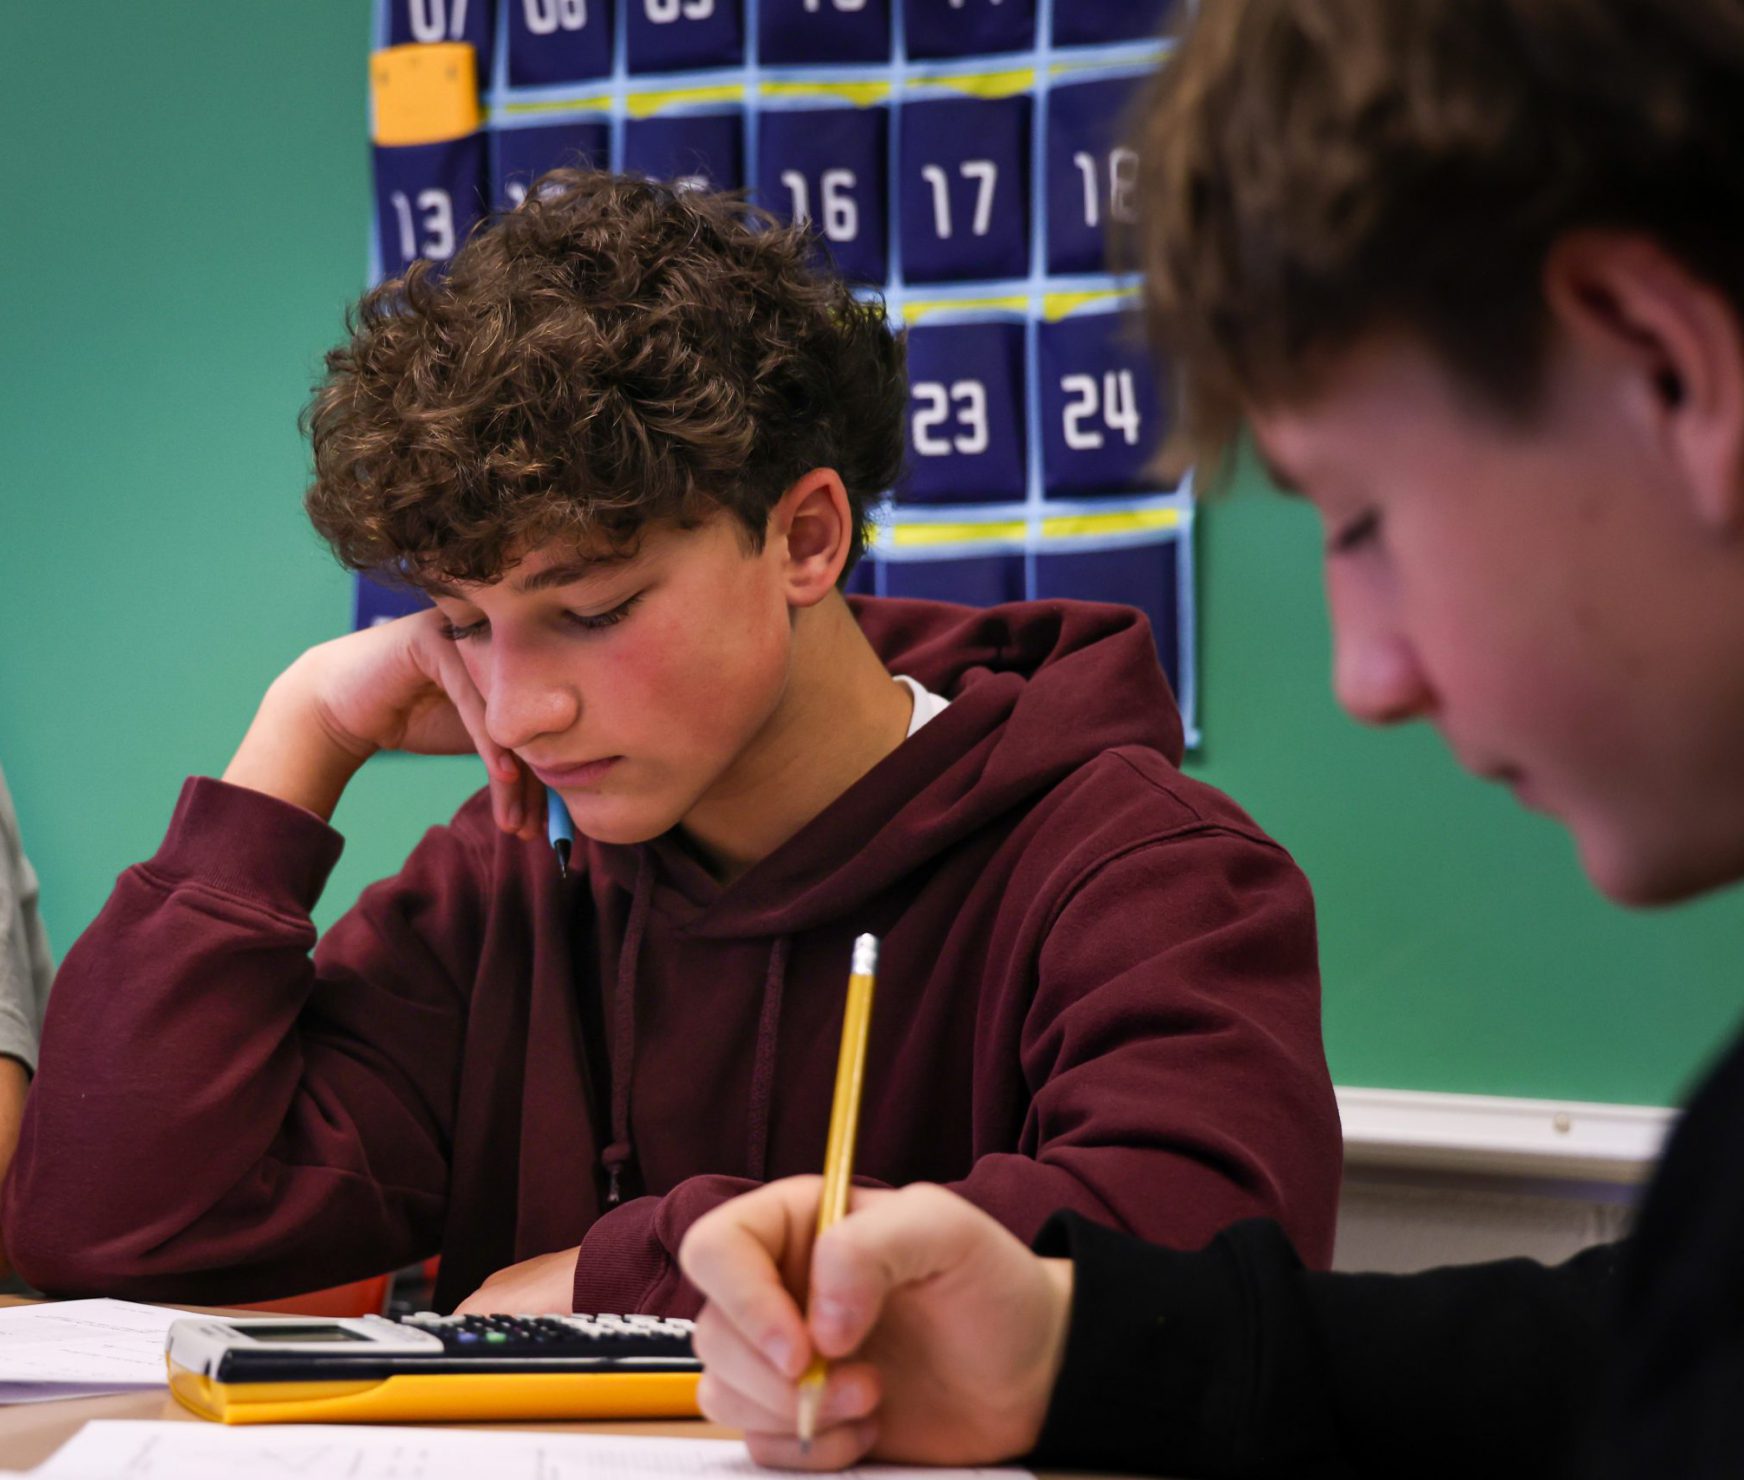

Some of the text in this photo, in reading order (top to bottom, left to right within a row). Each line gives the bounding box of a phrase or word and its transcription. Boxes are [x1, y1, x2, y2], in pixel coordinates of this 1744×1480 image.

[391, 189, 455, 261] 13
[781, 169, 857, 241] 16
[922, 160, 996, 239] 17
[912, 380, 988, 456] 23
[1061, 369, 1139, 450] 24
